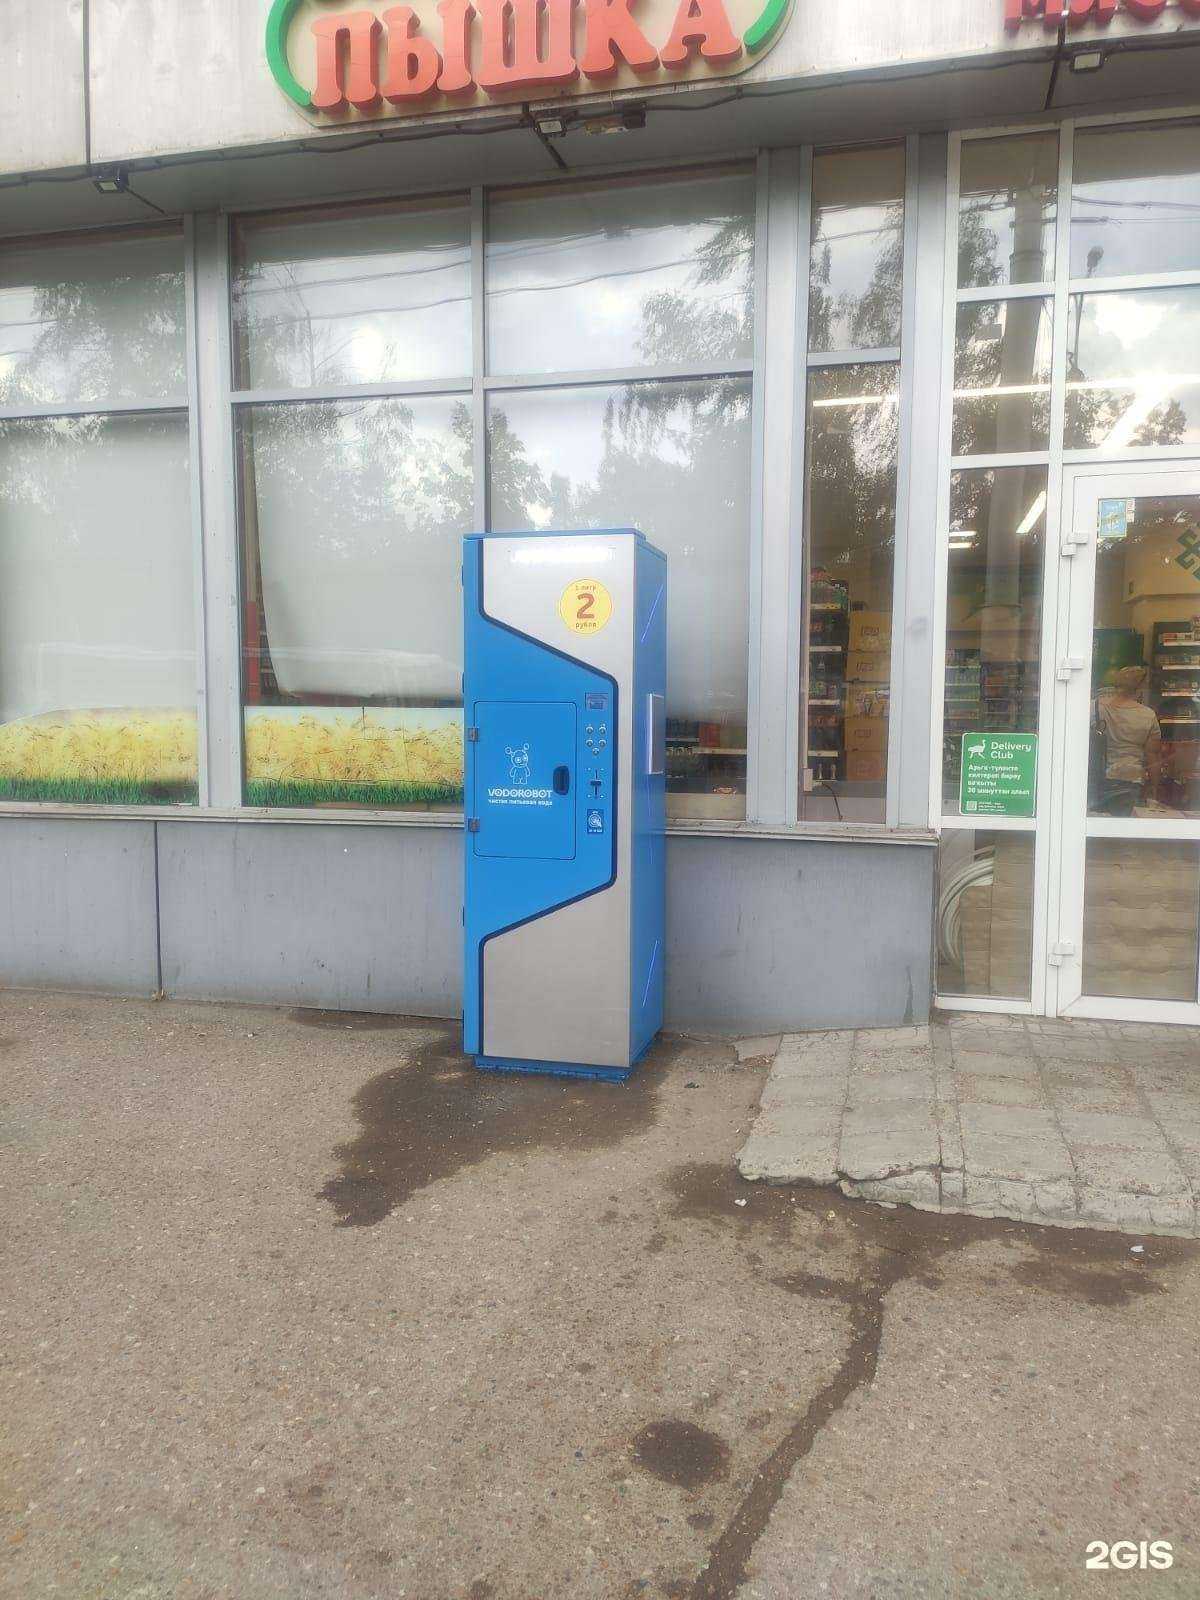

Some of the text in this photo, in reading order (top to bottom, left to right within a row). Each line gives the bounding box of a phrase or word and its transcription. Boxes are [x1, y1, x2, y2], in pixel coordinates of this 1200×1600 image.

[311, 0, 743, 109] ПЫШКА
[576, 593, 595, 619] 2
[990, 741, 1032, 752] Delivery
[990, 751, 1014, 759] Club
[487, 788, 553, 798] VODOROBOT
